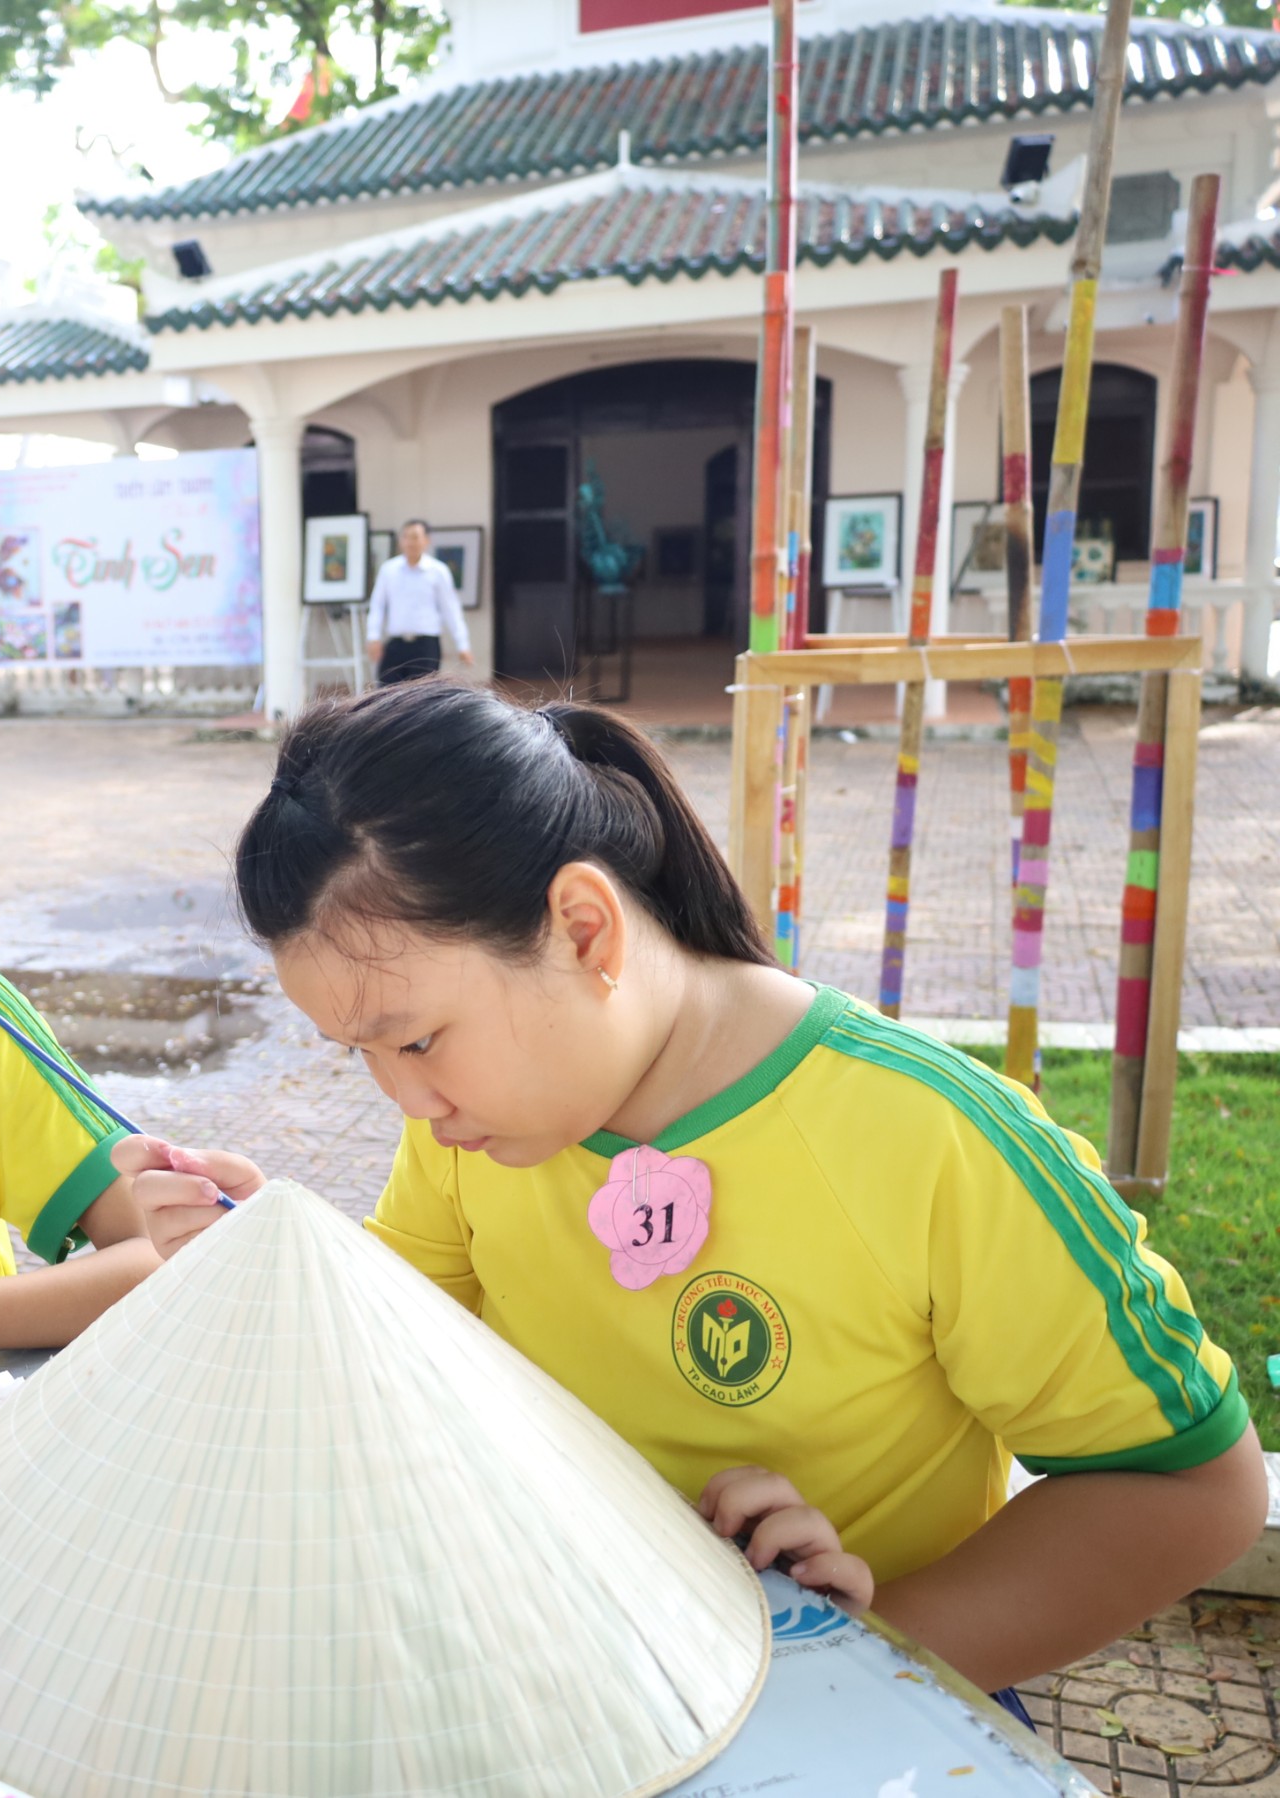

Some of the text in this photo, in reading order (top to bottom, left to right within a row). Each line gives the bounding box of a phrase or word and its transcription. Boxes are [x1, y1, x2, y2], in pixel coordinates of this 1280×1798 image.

[631, 1202, 676, 1247] 31
[677, 1282, 705, 1329] TRƯỜNG
[705, 1274, 732, 1288] TIỂU
[735, 1280, 763, 1302] HỌC
[773, 1323, 787, 1351] PHÚ
[702, 1383, 726, 1401] CAO
